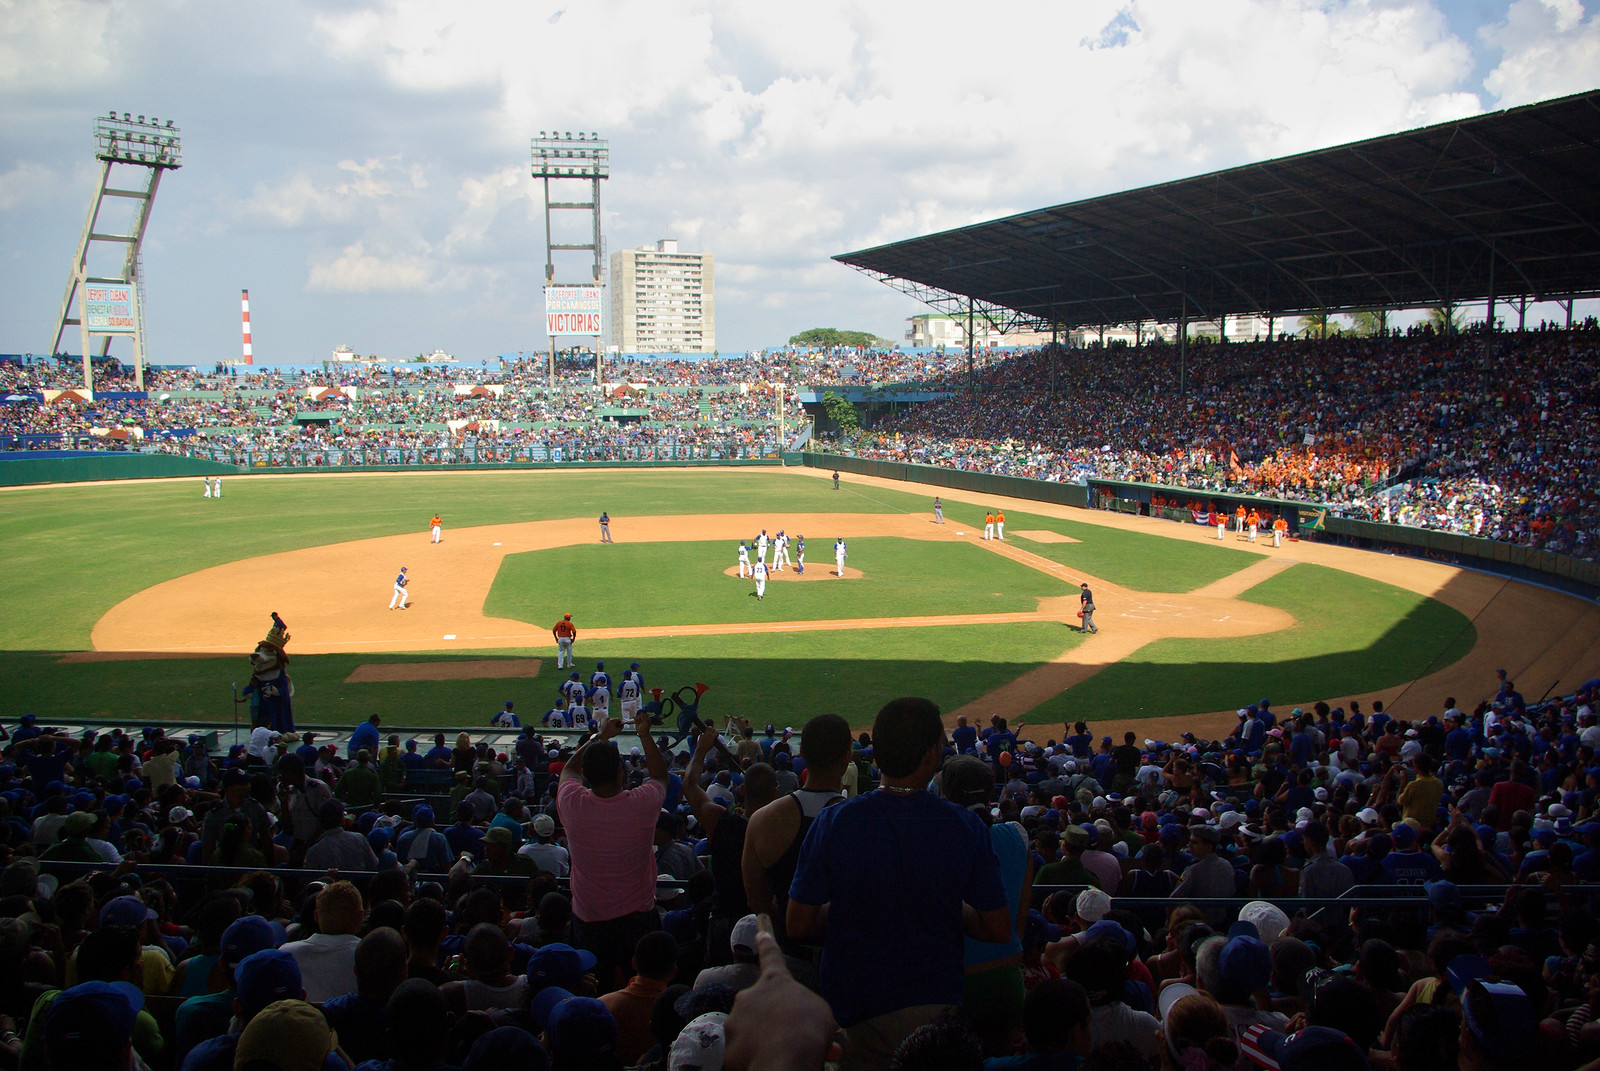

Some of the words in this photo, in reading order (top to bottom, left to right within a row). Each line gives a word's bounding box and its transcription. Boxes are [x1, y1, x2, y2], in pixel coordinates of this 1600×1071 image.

[580, 290, 599, 299] CUBANO
[547, 313, 600, 332] VICTORIAS
[625, 688, 634, 698] 72
[552, 718, 562, 728] 38
[575, 713, 585, 723] 69
